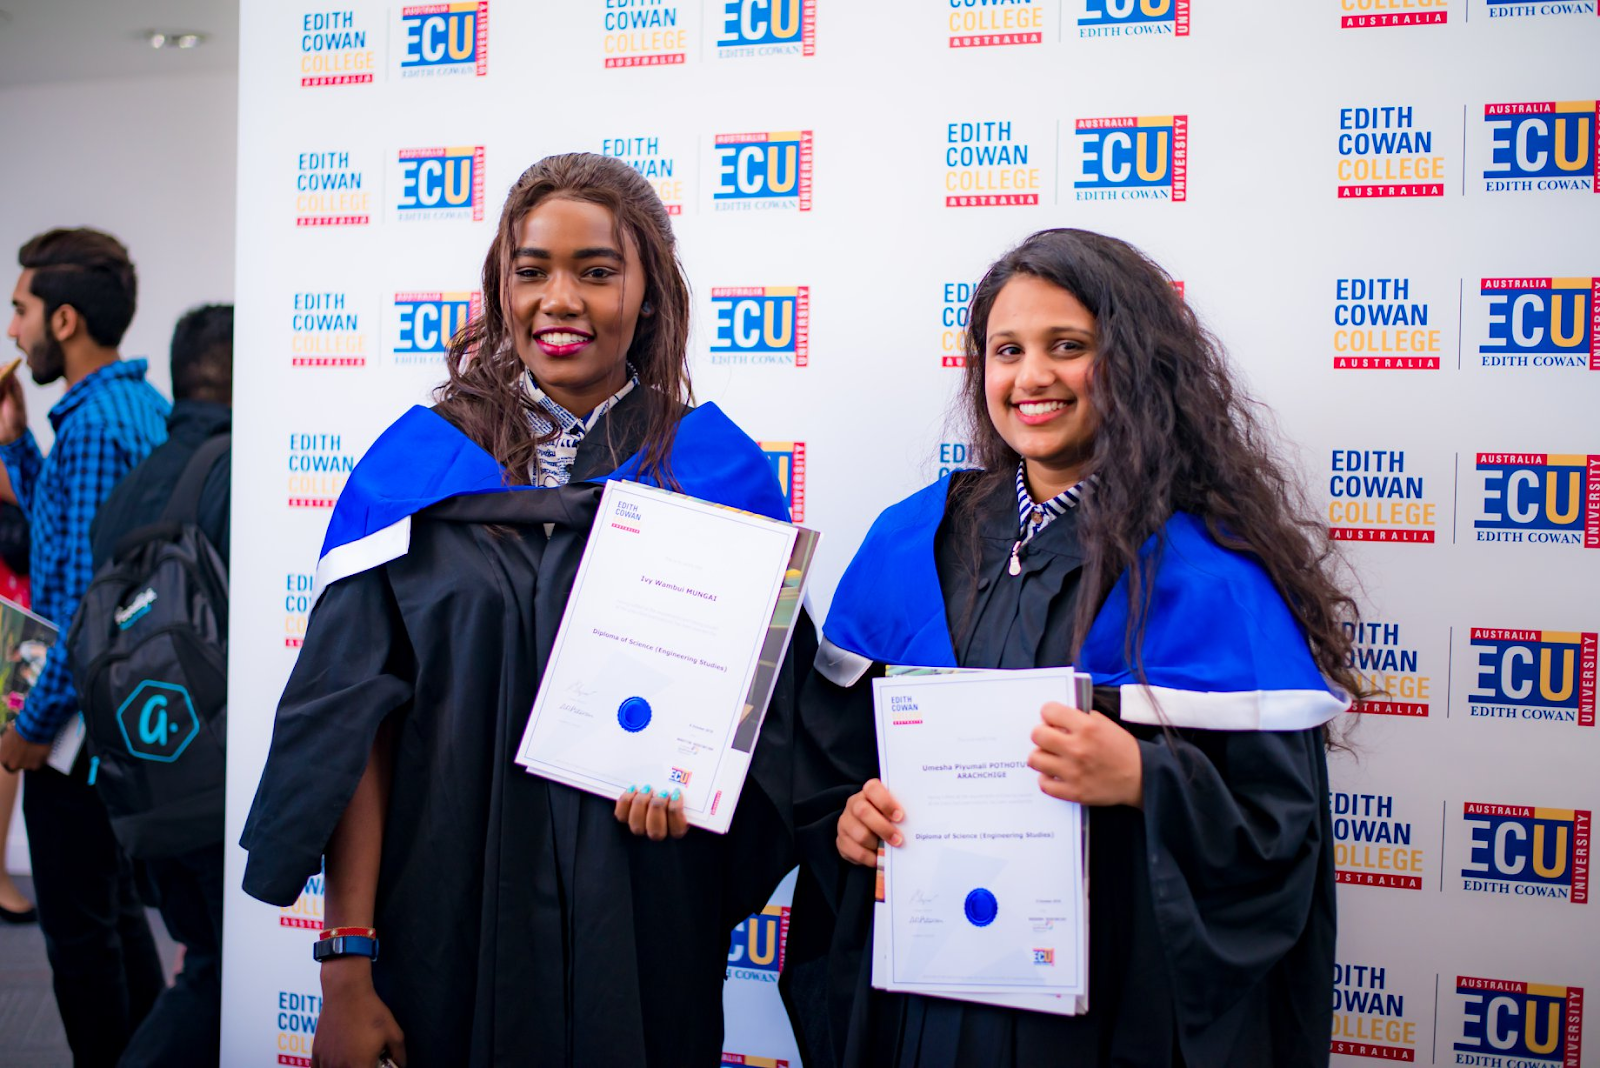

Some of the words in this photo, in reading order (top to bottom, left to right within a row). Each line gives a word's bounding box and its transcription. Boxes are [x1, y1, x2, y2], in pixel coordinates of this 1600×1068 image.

[303, 10, 353, 31] EDITH
[605, 8, 676, 31] COWAN
[719, 0, 800, 40] ECU
[949, 8, 1042, 32] COLLEGE
[1346, 14, 1442, 26] AUSTRALIA
[1489, 6, 1536, 18] EDITH
[1541, 2, 1595, 15] COWAN
[302, 31, 366, 52] COWAN
[402, 15, 474, 62] ECU
[478, 2, 488, 75] UNIVERSITY
[952, 33, 1038, 47] AUSTRALIA
[1080, 26, 1120, 38] EDITH
[1125, 24, 1172, 36] COWAN
[604, 30, 686, 54] COLLEGE
[719, 48, 755, 59] EDITH
[758, 46, 800, 57] COWAN
[301, 51, 374, 73] COLLEGE
[606, 54, 684, 68] AUSTRALIA
[303, 75, 371, 86] AUSTRALIA
[1340, 106, 1413, 130] EDITH
[1488, 104, 1551, 114] AUSTRALIA
[948, 121, 1011, 142] EDITH
[1078, 118, 1134, 128] AUSTRALIA
[603, 137, 658, 157] EDITH
[716, 133, 767, 144] AUSTRALIA
[1338, 132, 1432, 156] COWAN
[1484, 118, 1590, 172] ECU
[299, 152, 349, 170] EDITH
[946, 145, 1028, 167] COWAN
[1076, 132, 1168, 182] ECU
[1174, 118, 1186, 200] UNIVERSITY
[715, 146, 797, 194] ECU
[801, 133, 812, 210] UNIVERSITY
[1338, 157, 1444, 181] COLLEGE
[297, 172, 362, 191] COWAN
[399, 159, 472, 205] ECU
[946, 168, 1040, 192] COLLEGE
[1486, 180, 1532, 192] EDITH
[1537, 179, 1592, 191] COWAN
[948, 194, 1035, 206] AUSTRALIA
[1076, 190, 1117, 201] EDITH
[1121, 188, 1168, 200] COWAN
[1344, 186, 1438, 197] AUSTRALIA
[296, 192, 370, 213] COLLEGE
[715, 201, 750, 212] EDITH
[754, 200, 796, 210] COWAN
[1336, 278, 1409, 300] EDITH
[1485, 279, 1548, 289] AUSTRALIA
[294, 294, 345, 310] EDITH
[292, 314, 357, 331] COWAN
[711, 300, 793, 348] ECU
[1334, 304, 1428, 326] COWAN
[1480, 294, 1586, 348] ECU
[394, 303, 466, 350] ECU
[798, 288, 808, 366] UNIVERSITY
[292, 334, 366, 352] COLLEGE
[1334, 330, 1440, 352] COLLEGE
[712, 355, 748, 365] EDITH
[751, 354, 793, 365] COWAN
[1340, 358, 1434, 368] AUSTRALIA
[1482, 356, 1528, 367] EDITH
[1533, 356, 1587, 368] COWAN
[290, 434, 341, 450] EDITH
[289, 455, 354, 472] COWAN
[1332, 450, 1404, 472] EDITH
[1480, 454, 1542, 464] AUSTRALIA
[289, 476, 347, 494] COLLE
[793, 444, 804, 522] UNIVERSITY
[1330, 476, 1423, 499] COWAN
[618, 501, 638, 512] EDITH
[1475, 469, 1580, 525] ECU
[1588, 458, 1600, 545] UNIVERSITY
[616, 508, 642, 520] COWAN
[1329, 501, 1436, 526] COLLEGE
[1334, 530, 1430, 542] AUSTRALIA
[1476, 531, 1522, 542] EDITH
[1528, 532, 1582, 544] COWAN
[287, 574, 312, 592] EDI
[640, 575, 653, 586] Ivy
[655, 578, 684, 593] Wambui
[686, 588, 718, 602] MUNGAI
[1342, 622, 1398, 645] DITH
[1474, 629, 1537, 641] AUSTRALIA
[592, 628, 620, 642] Diploma
[628, 638, 654, 652] Science
[655, 646, 698, 664] (Engineering
[699, 659, 728, 673] Studies)
[1468, 645, 1574, 702] ECU
[1582, 636, 1596, 723] UNIVERSITY
[1357, 674, 1430, 699] LLEGE
[892, 704, 918, 712] COWAN
[1352, 702, 1423, 714] STRALIA
[1470, 706, 1516, 718] EDITH
[1522, 708, 1576, 722] COWAN
[1468, 804, 1530, 816] AUSTRALIA
[916, 832, 942, 840] Diploma
[1334, 818, 1411, 845] OWAN
[1334, 844, 1424, 872] OLLEGE
[1462, 820, 1568, 878] ECU
[1574, 814, 1589, 900] UNIVERSITY
[1463, 880, 1510, 894] EDITH
[1514, 884, 1568, 898] COWAN
[735, 968, 776, 982] COWAN
[1334, 964, 1386, 990] DITH
[1460, 978, 1522, 992] AUSTRALIA
[1333, 988, 1404, 1017] OWAN
[278, 1012, 318, 1034] COW
[1332, 1014, 1416, 1044] OLLEGE
[1454, 992, 1560, 1055] ECU
[1567, 992, 1580, 1068] NIVERSITY
[1331, 1042, 1409, 1060] STRALIA
[1456, 1053, 1502, 1068] EDITH
